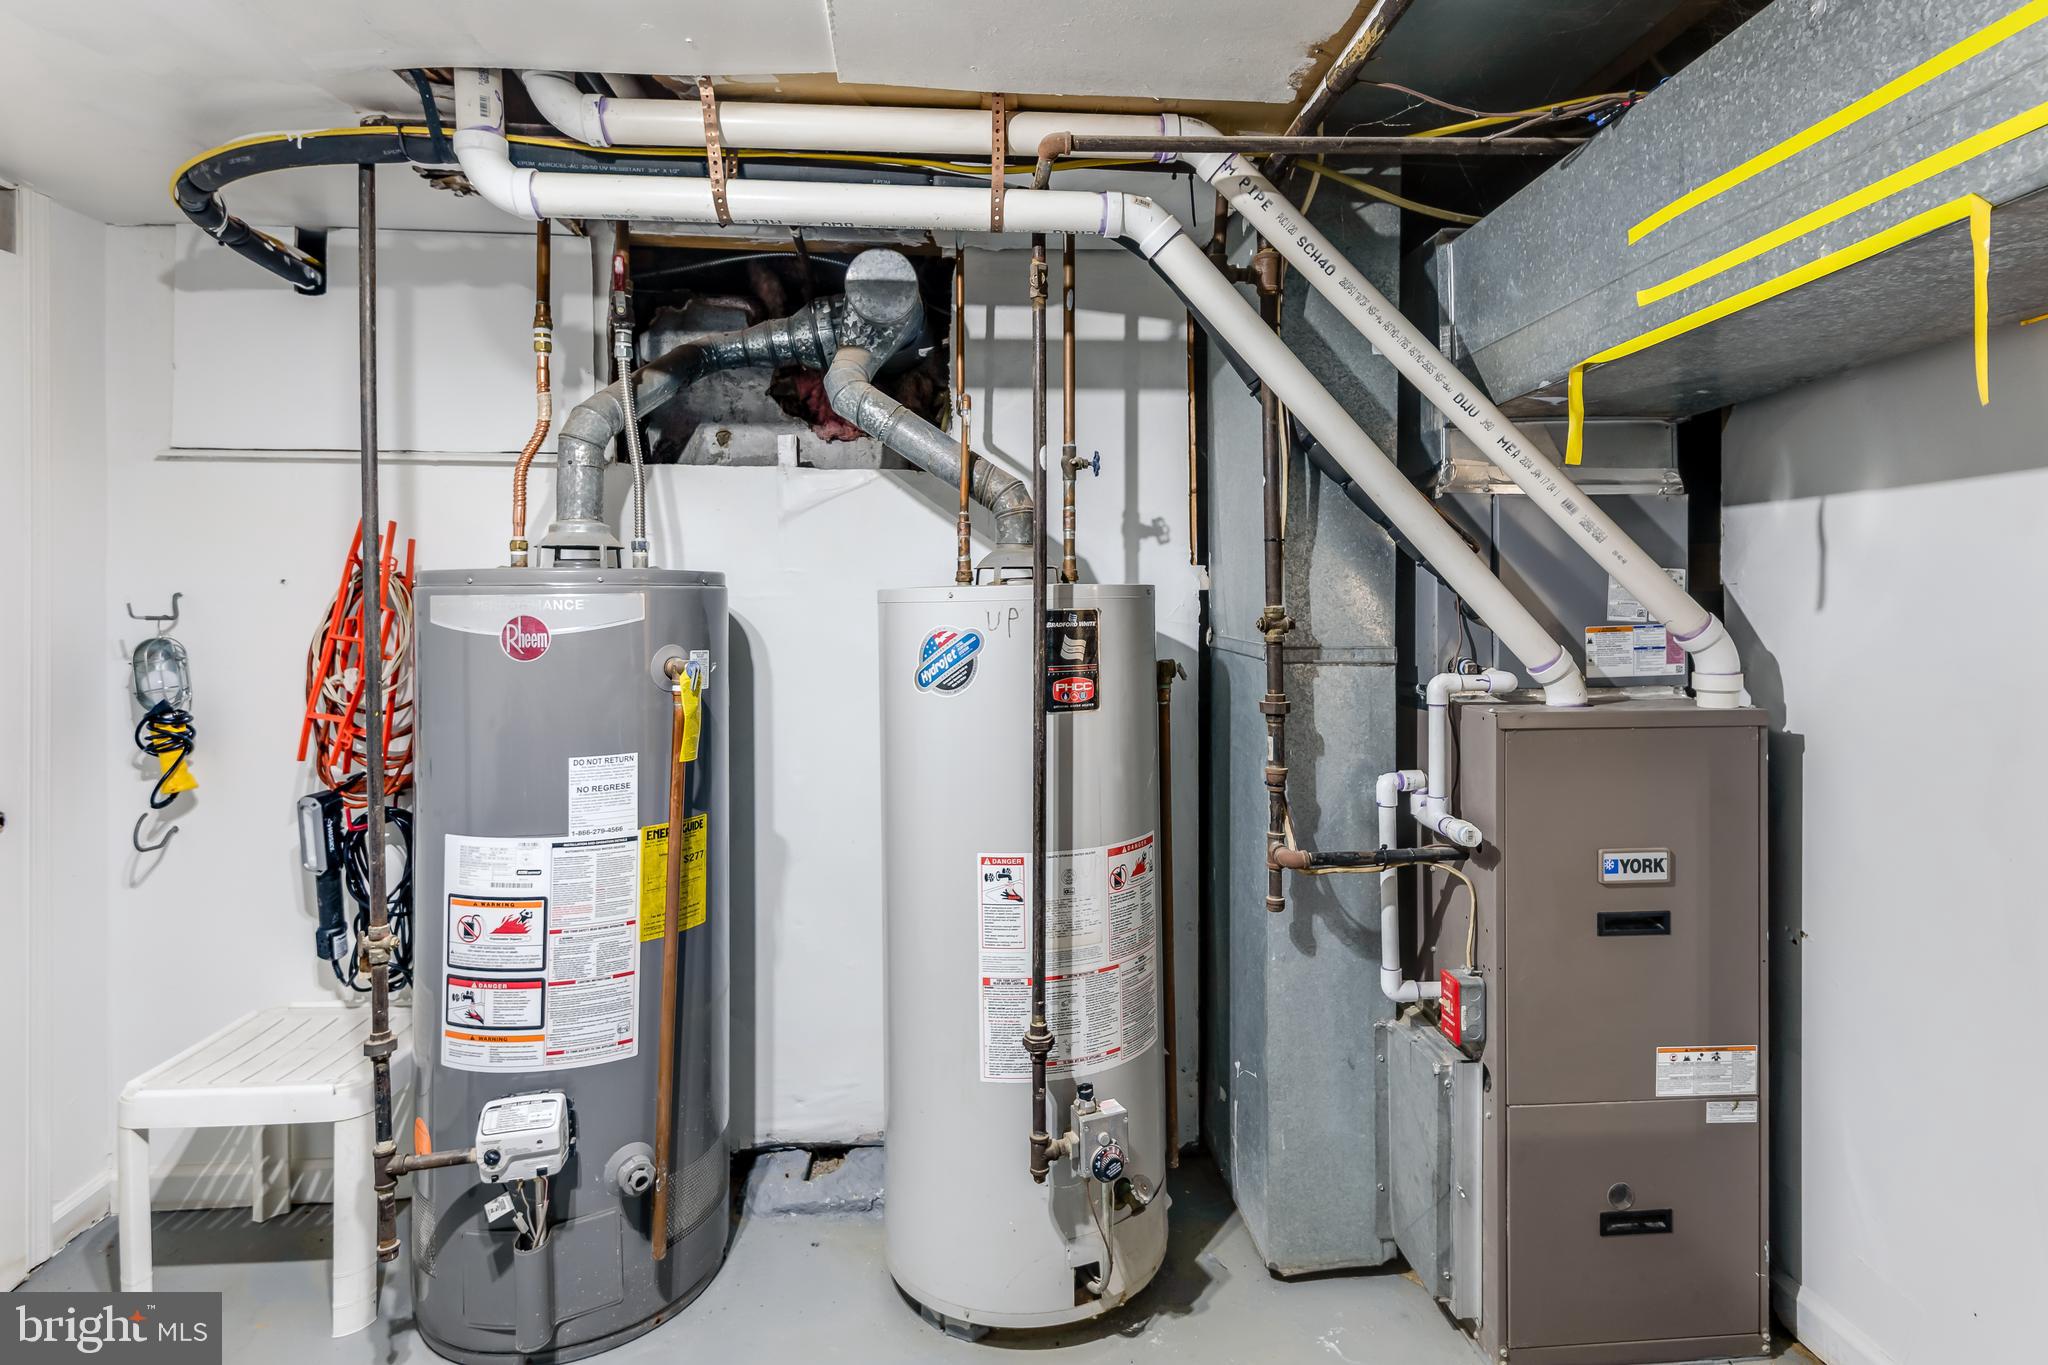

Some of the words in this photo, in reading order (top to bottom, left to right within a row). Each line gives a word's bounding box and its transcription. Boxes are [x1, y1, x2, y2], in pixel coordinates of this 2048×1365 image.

[1239, 176, 1273, 212] PIPE
[1296, 235, 1336, 277] SCH40
[1496, 435, 1521, 459] MEA
[1046, 620, 1078, 628] BRADFORD
[506, 616, 548, 654] Rheem
[1056, 682, 1093, 692] PHCC
[587, 757, 602, 765] NOT
[604, 755, 635, 764] RETURN
[591, 782, 631, 792] REGRESE
[1619, 858, 1665, 874] YORK
